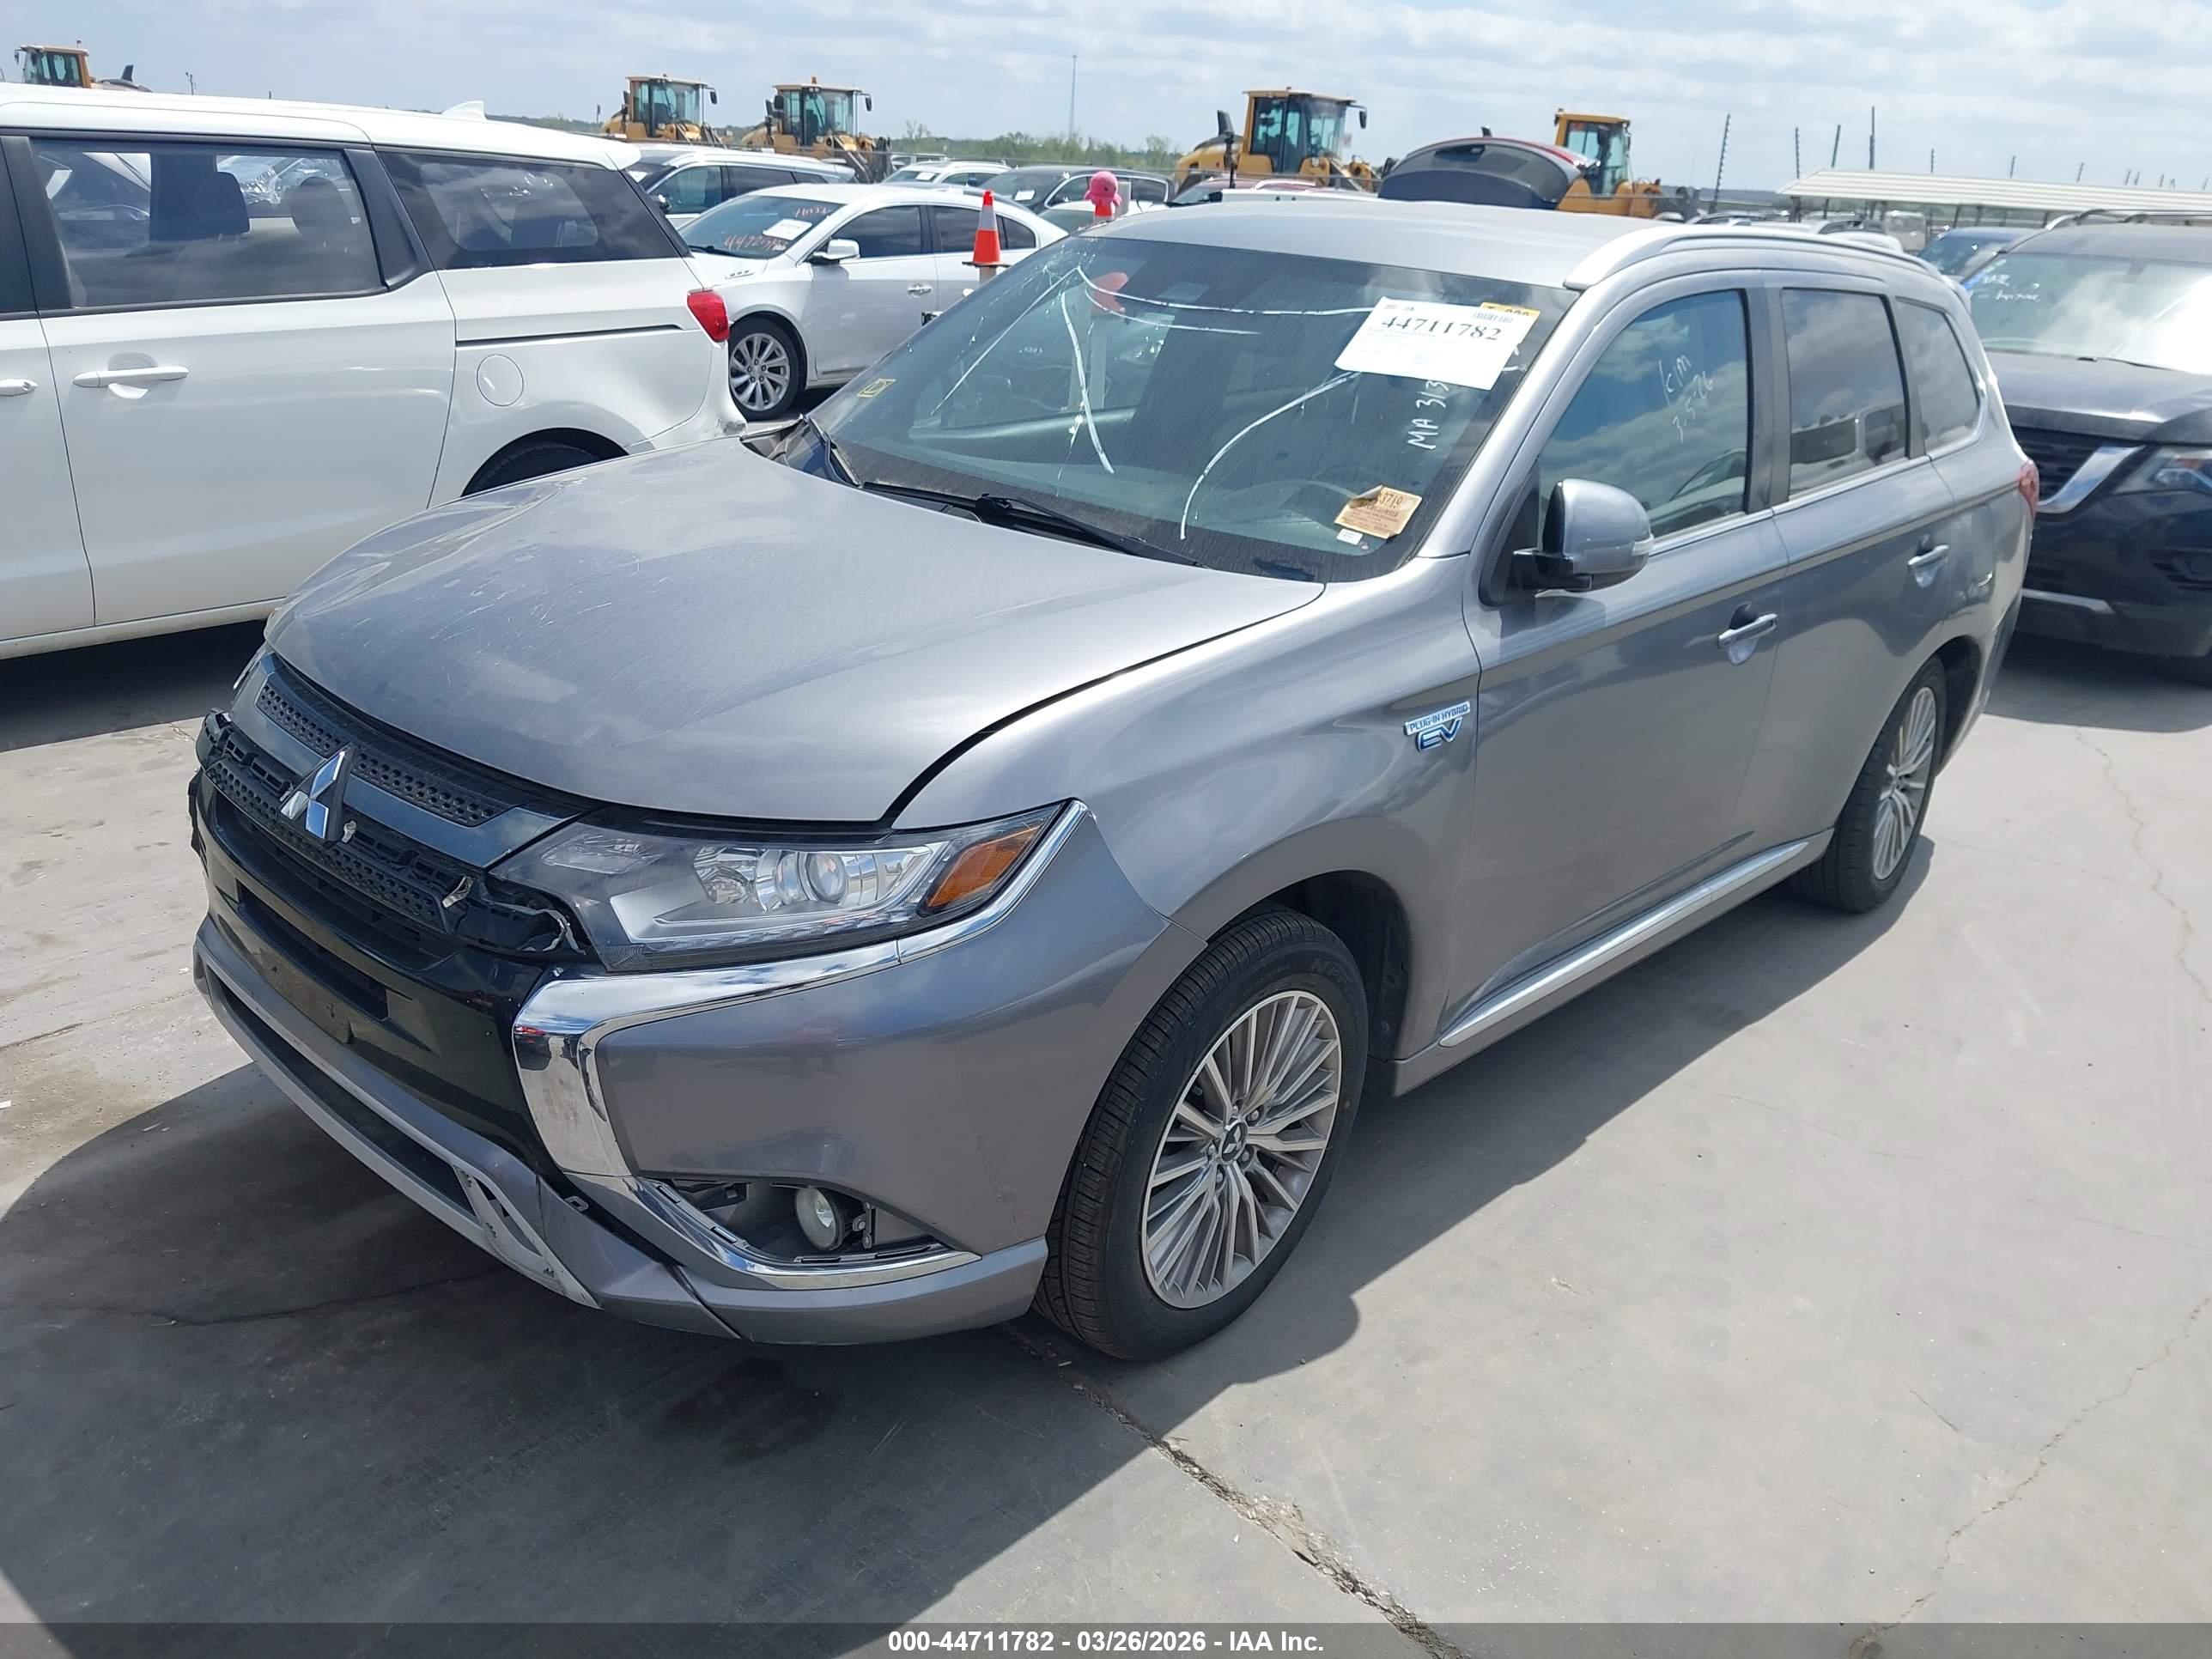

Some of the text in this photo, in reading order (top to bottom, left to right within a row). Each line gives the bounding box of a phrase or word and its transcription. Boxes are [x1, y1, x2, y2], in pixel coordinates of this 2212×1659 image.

[1381, 315, 1504, 341] 44711782
[1409, 704, 1468, 732] PLUG-IN HYBRID
[1419, 716, 1463, 750] EV
